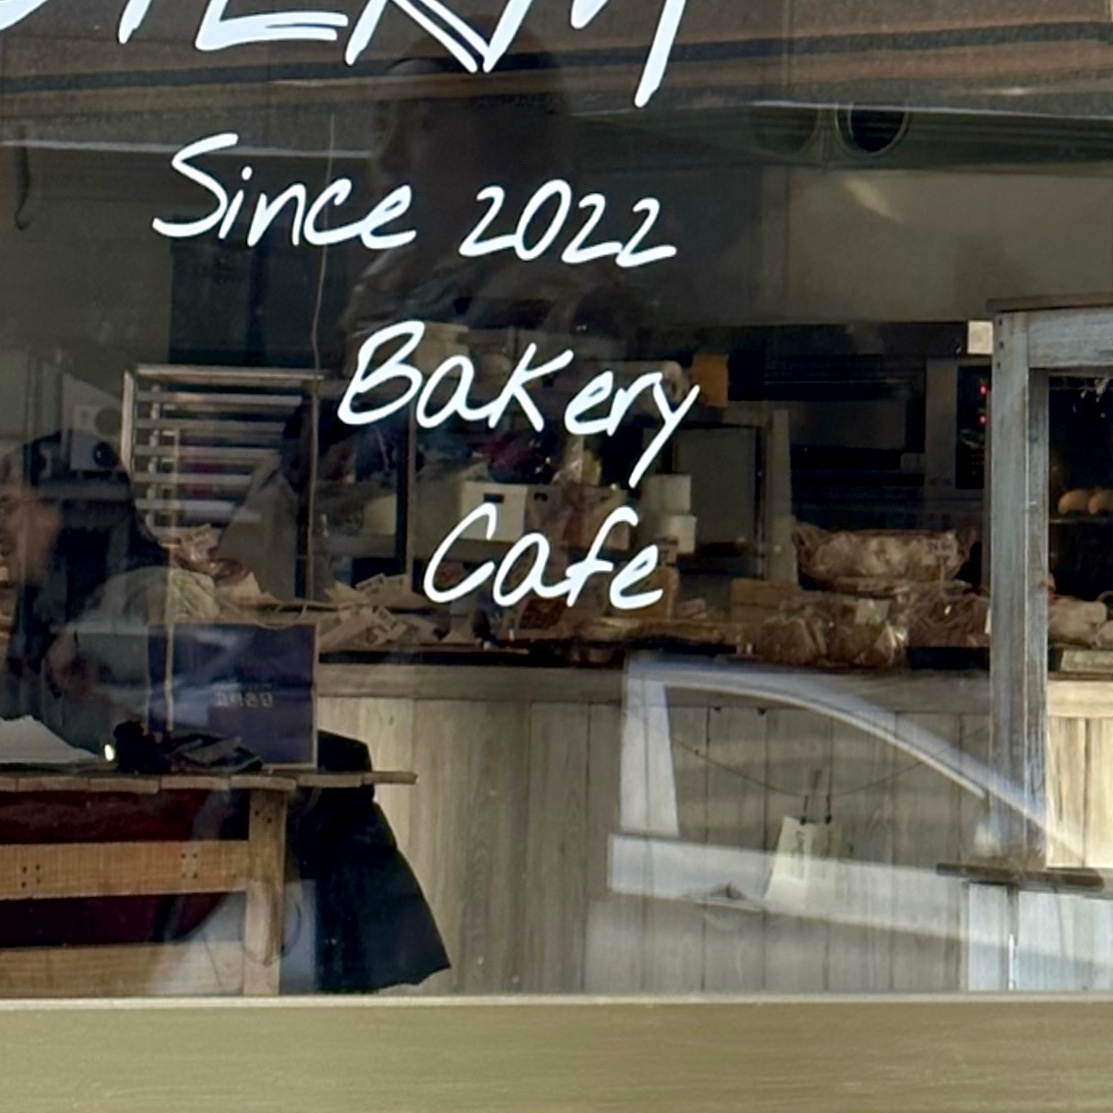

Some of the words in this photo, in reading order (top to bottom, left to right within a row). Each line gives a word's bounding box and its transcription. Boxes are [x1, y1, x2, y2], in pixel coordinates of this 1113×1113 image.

[152, 133, 417, 250] Since
[459, 179, 678, 268] 2022
[423, 502, 664, 610] Cafe
